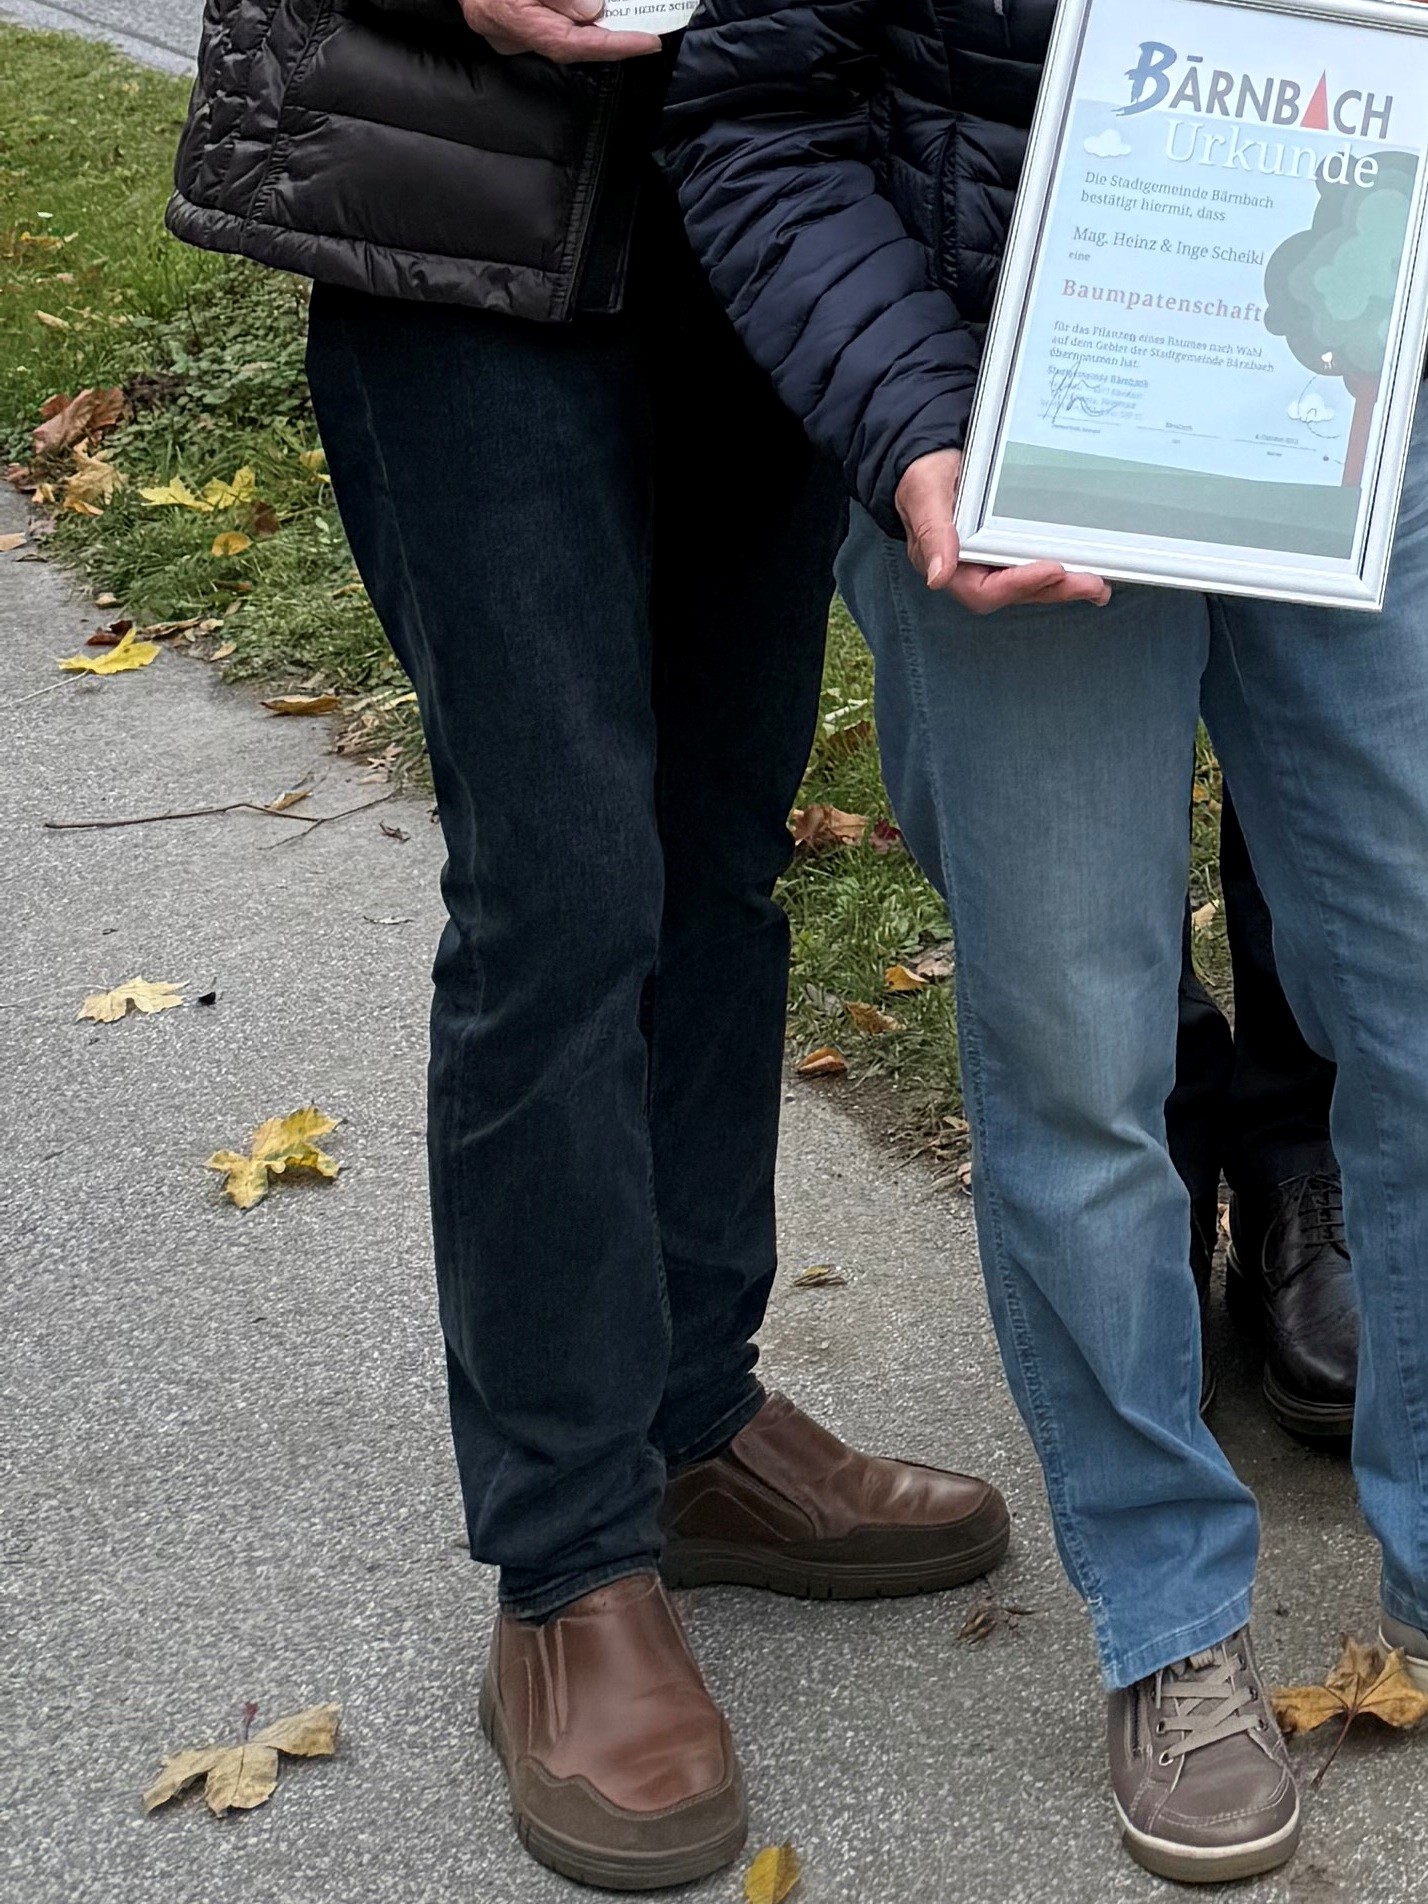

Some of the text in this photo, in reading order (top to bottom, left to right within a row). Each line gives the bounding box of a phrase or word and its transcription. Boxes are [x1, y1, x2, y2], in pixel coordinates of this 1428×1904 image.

[1165, 117, 1379, 188] Urkunde
[1080, 189, 1138, 212] bestätigt
[1196, 207, 1226, 222] dass
[1084, 171, 1274, 209] Die Stadtgemeinde Bärnbach
[1068, 250, 1091, 262] eine
[1073, 226, 1109, 247] Mag.
[1113, 231, 1157, 251] Heinz
[1160, 238, 1172, 253] &
[1176, 240, 1209, 261] Inge
[1061, 279, 1263, 322] Baumpatenschaft
